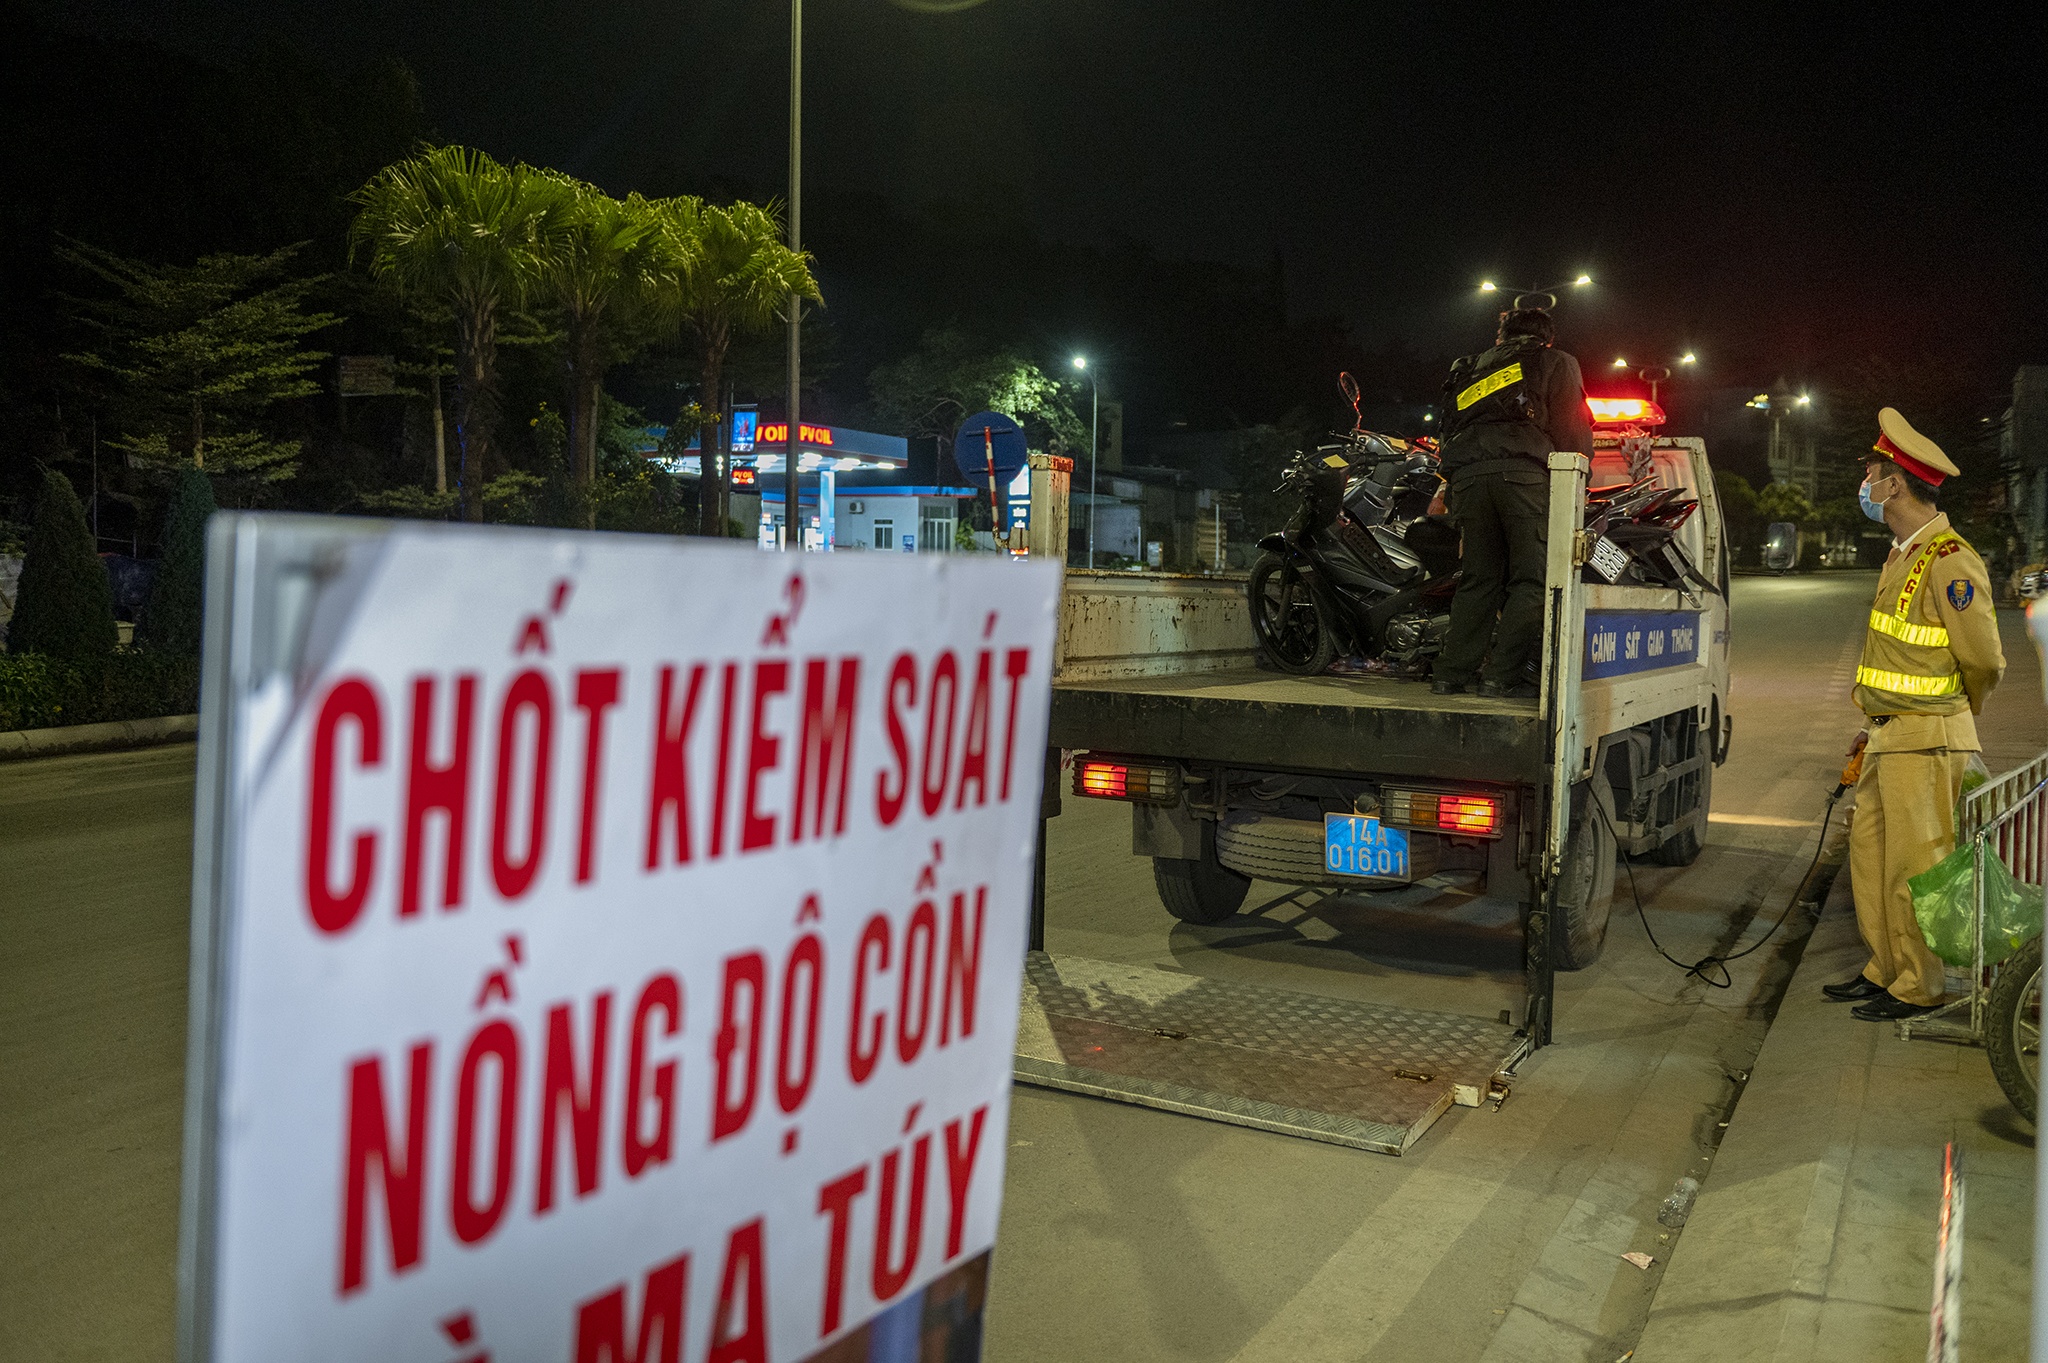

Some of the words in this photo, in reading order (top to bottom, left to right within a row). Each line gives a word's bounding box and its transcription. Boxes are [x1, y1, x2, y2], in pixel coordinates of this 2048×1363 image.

[1591, 625, 1617, 663] CẢNH
[1625, 624, 1641, 659] SÁT
[1647, 629, 1665, 657] GIAO
[303, 577, 623, 938] CHỐT
[642, 570, 860, 874] KIỂM
[875, 610, 1031, 828] SOÁT
[1328, 843, 1404, 876] 016.01
[1348, 818, 1388, 846] 14A
[338, 932, 685, 1298] NỒNG
[708, 891, 826, 1158] ĐỘ
[847, 837, 989, 1087] CỒN
[815, 1099, 990, 1342] TÚY
